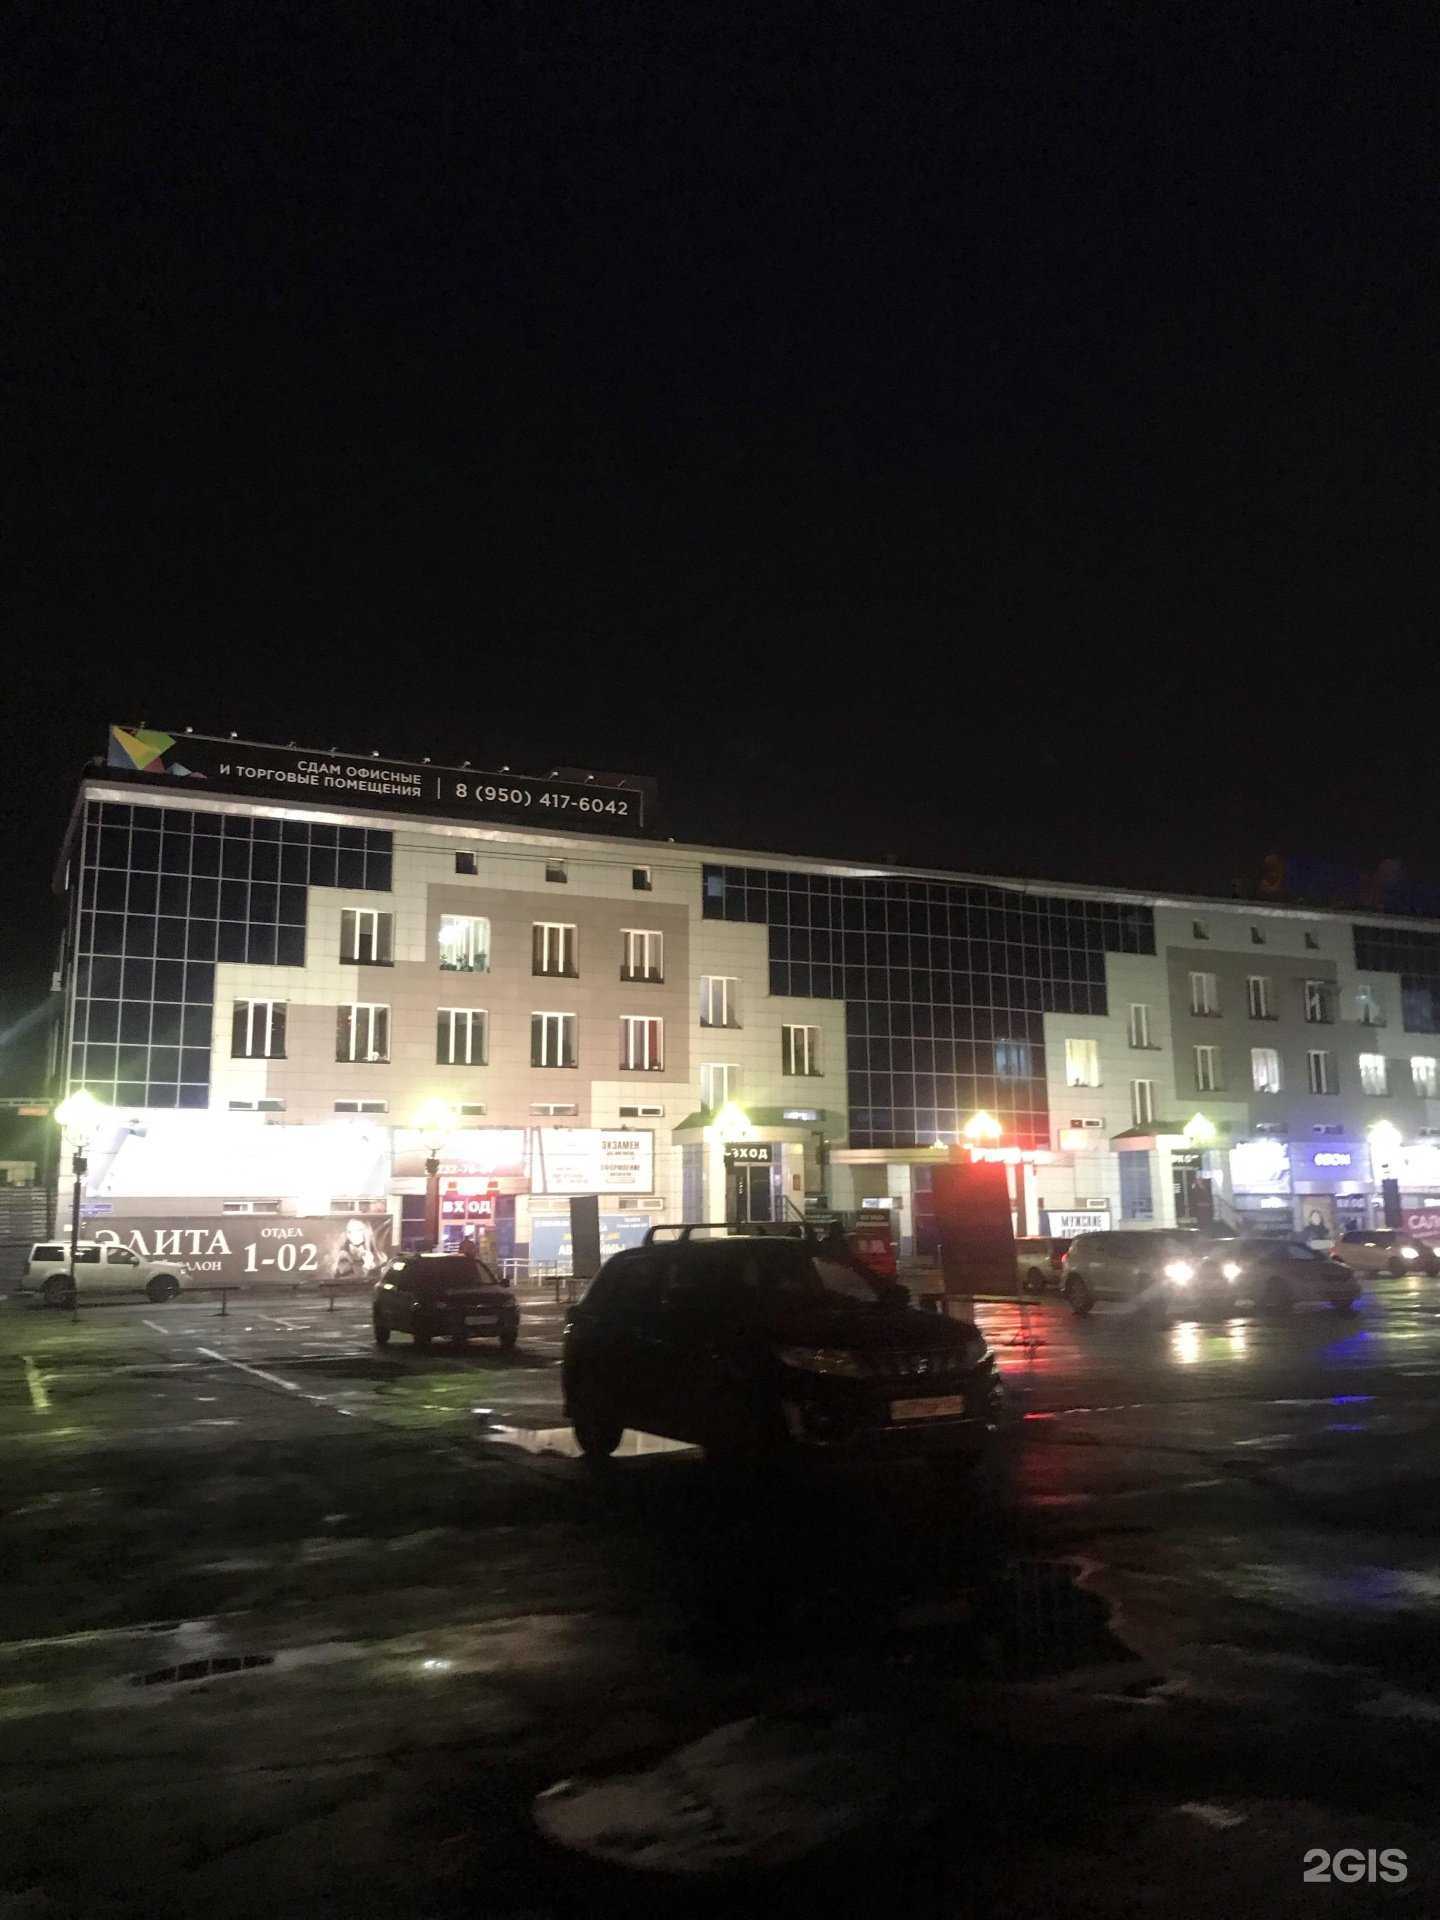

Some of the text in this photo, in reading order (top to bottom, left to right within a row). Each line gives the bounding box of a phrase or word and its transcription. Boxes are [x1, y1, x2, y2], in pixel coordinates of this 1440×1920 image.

[219, 764, 421, 797] И ТОРГОВЫЕ ПОМЕЩЕНИЯ
[297, 760, 421, 785] СДАМ ОФИСНЫЕ
[455, 783, 628, 816] 8 (950) 417-6042
[442, 1200, 491, 1214] ВХОД
[261, 1227, 304, 1239] ОТДЕЛ
[243, 1242, 319, 1272] 1-02
